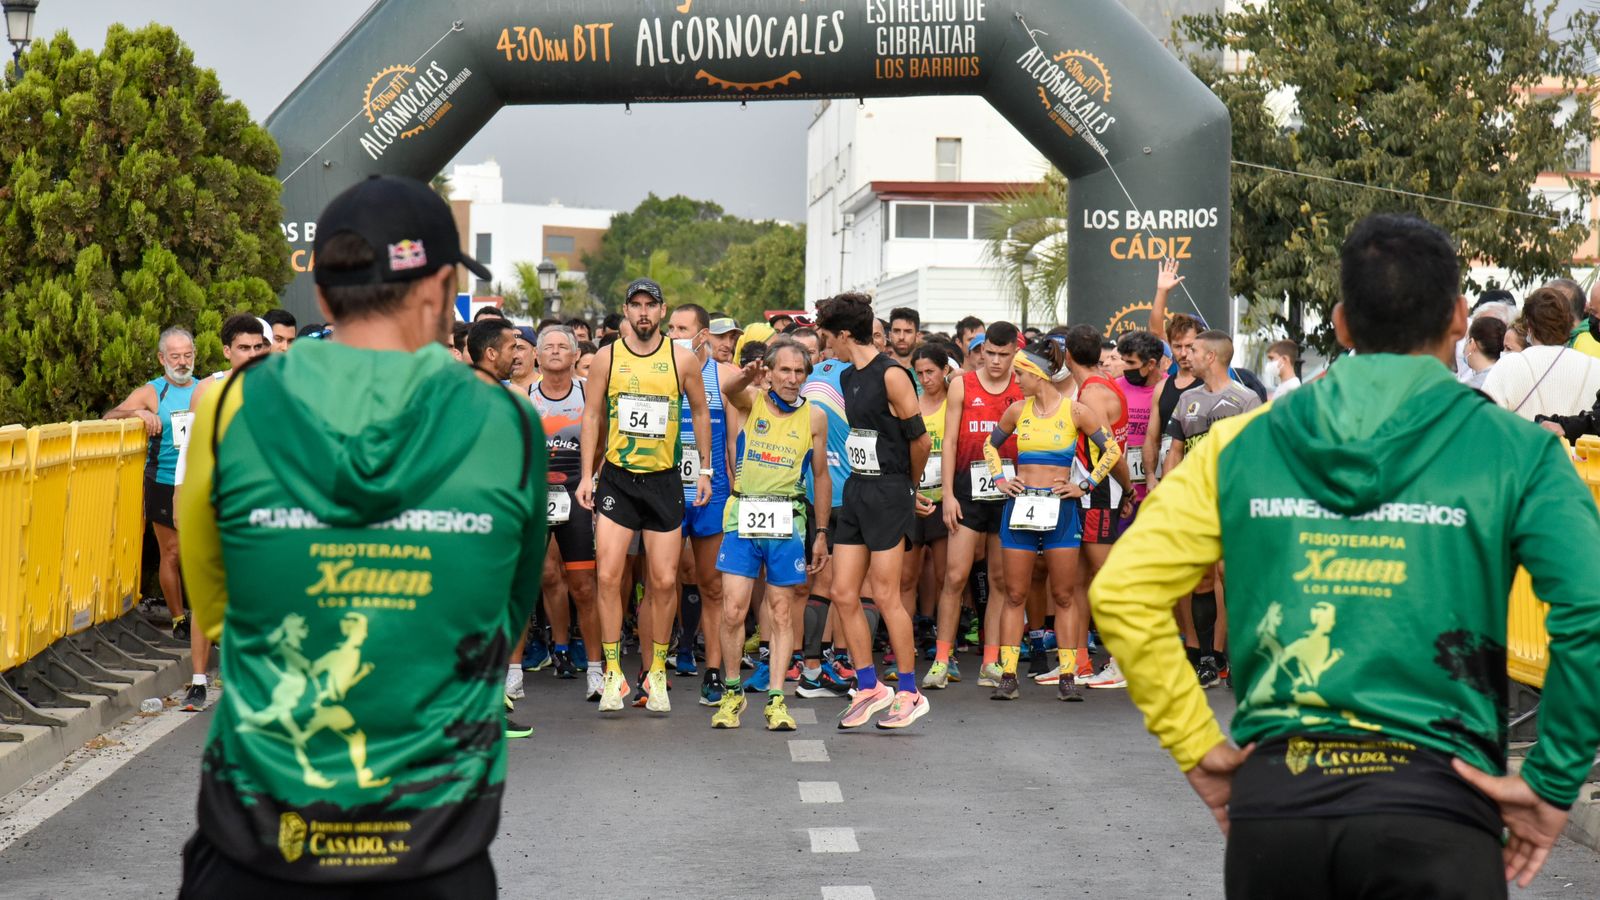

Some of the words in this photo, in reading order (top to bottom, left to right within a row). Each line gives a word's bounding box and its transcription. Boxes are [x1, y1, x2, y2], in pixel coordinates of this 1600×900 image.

[866, 0, 957, 24] ESTRECHO
[963, 0, 986, 22] DE
[573, 23, 614, 63] BTT
[636, 10, 845, 67] ALCORNOCALES
[876, 25, 976, 56] GIBRALTAR
[875, 58, 905, 79] LOS
[909, 56, 981, 78] BARRIOS
[1016, 45, 1117, 135] ALCORNOCALES
[359, 60, 449, 161] ALCORNOCALES
[1083, 209, 1121, 230] LOS
[1125, 207, 1218, 230] BARRIOS
[1109, 233, 1192, 260] CÁDIZ
[629, 411, 649, 429] 54
[545, 440, 580, 451] NCHEZ
[750, 440, 798, 456] ESTEPONA
[979, 477, 997, 493] 24
[747, 512, 775, 529] 321
[1025, 505, 1035, 521] 4
[309, 543, 433, 560] FISIOTERAPIA
[1299, 531, 1407, 549] FISIOTERAPIA
[305, 559, 433, 597] Xauen
[1291, 549, 1408, 585] Xauen
[1303, 584, 1330, 595] LOS
[1332, 583, 1393, 598] BARRIOS
[317, 597, 348, 609] LOS
[351, 597, 417, 610] BARRIOS
